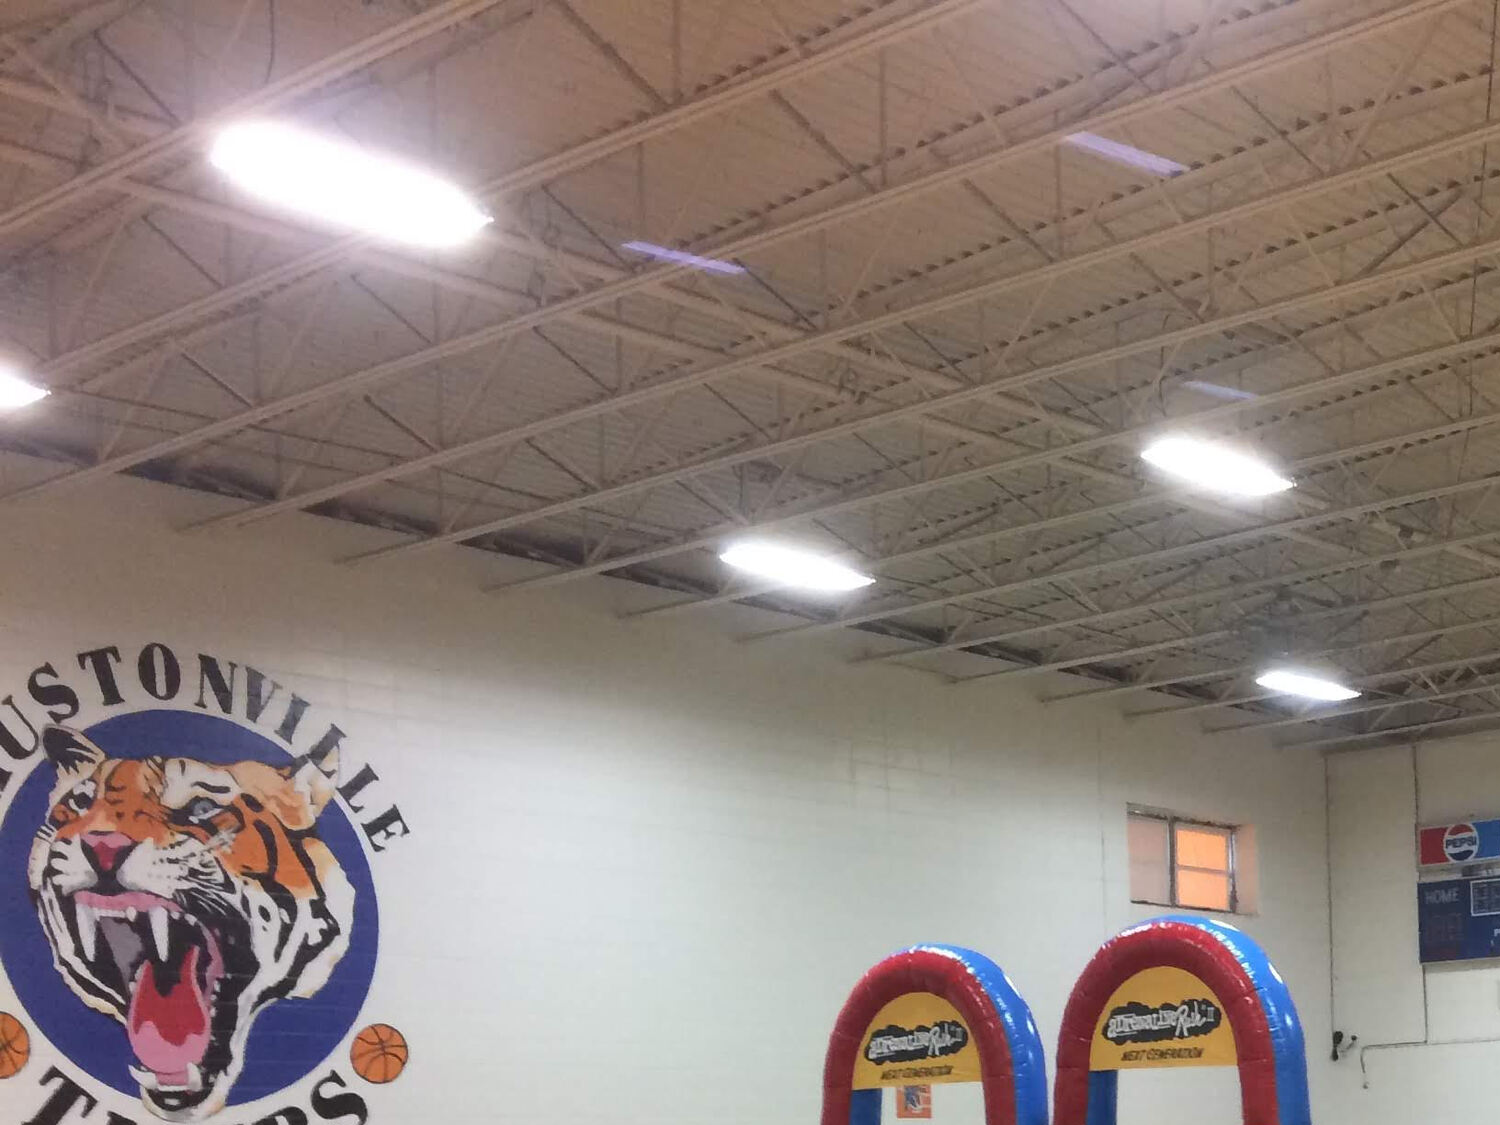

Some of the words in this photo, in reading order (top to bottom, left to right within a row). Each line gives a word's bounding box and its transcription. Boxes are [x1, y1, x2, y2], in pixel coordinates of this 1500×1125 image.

[0, 642, 411, 854] USTONVILLE
[1445, 835, 1478, 850] PEPSI
[1425, 887, 1459, 906] HOME
